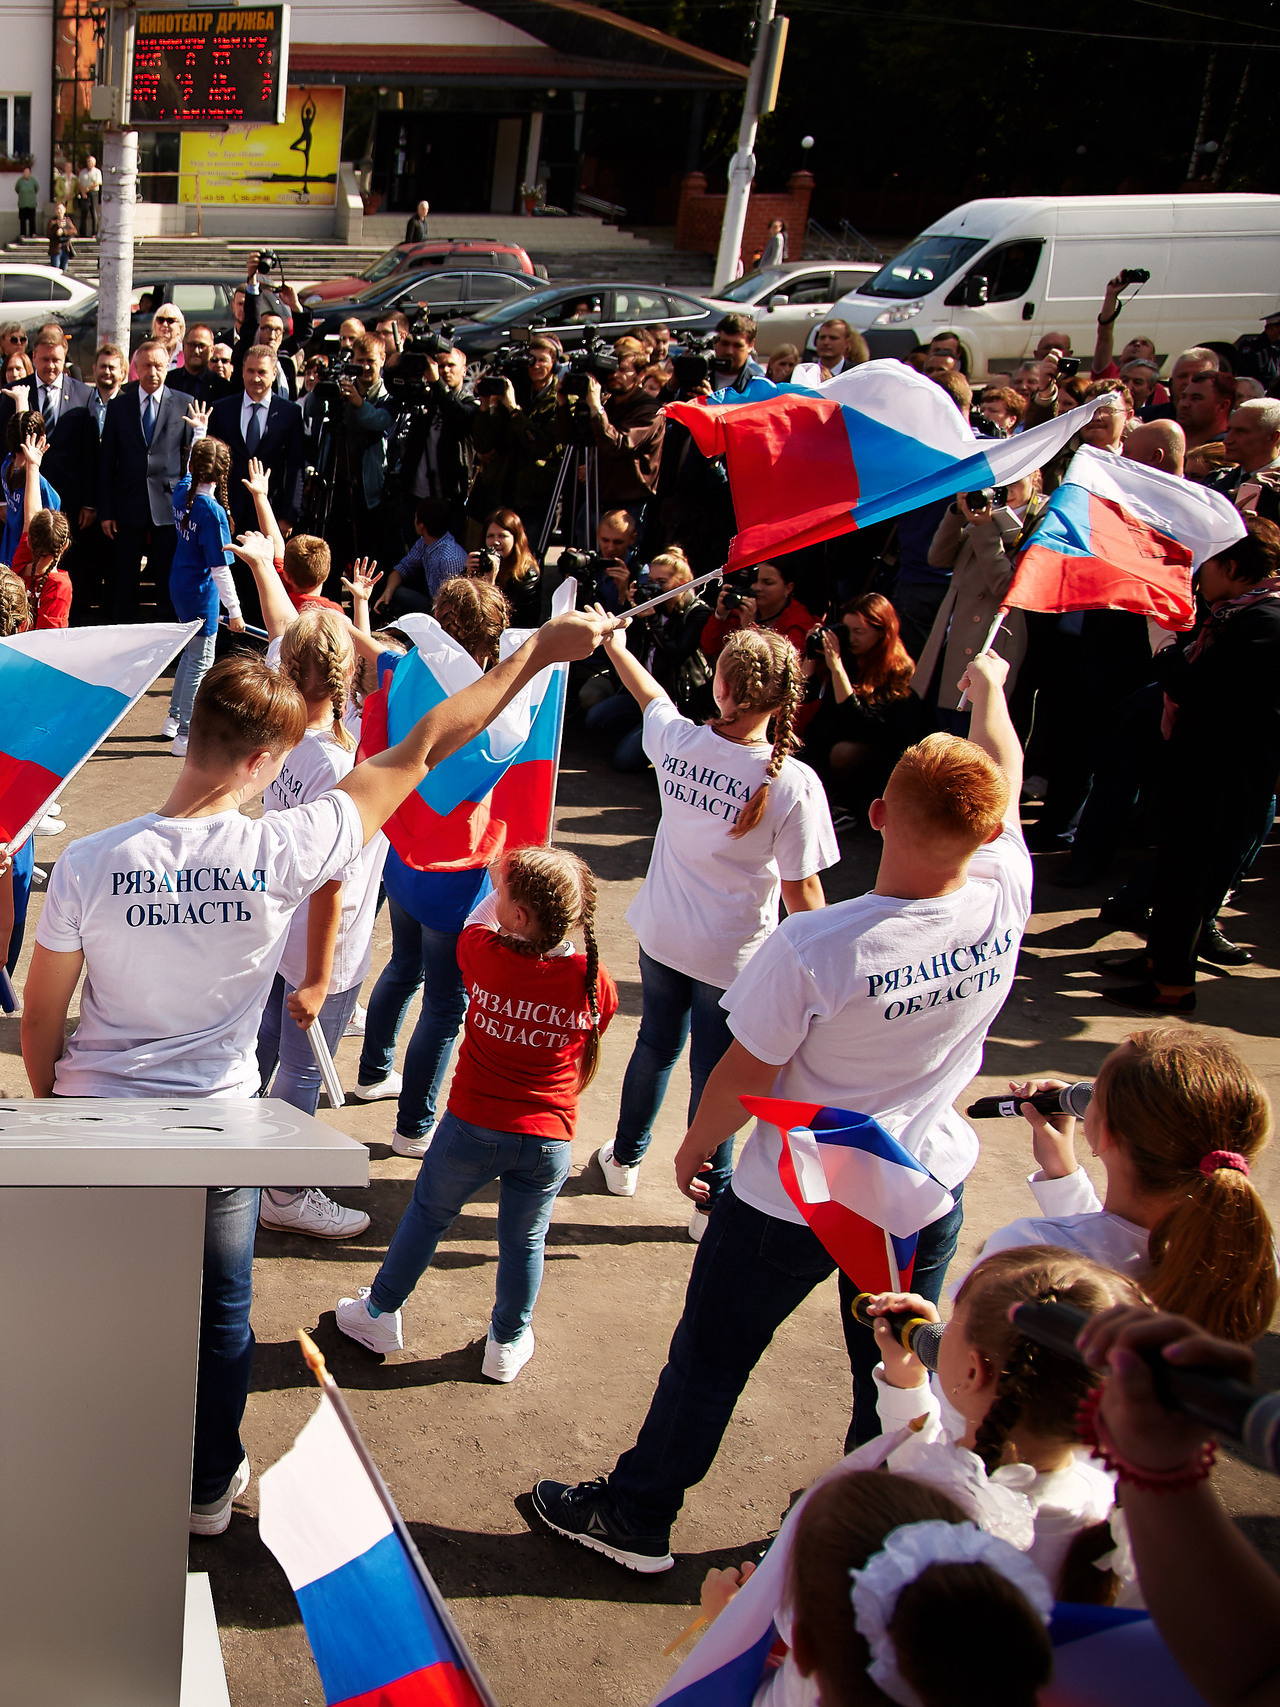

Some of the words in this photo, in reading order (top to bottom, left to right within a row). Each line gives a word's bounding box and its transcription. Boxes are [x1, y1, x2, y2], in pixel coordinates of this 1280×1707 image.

[139, 12, 213, 34] КИНОТЕАТР
[216, 11, 275, 34] ДРУЖБА
[661, 753, 751, 803] РЯЗАНСКА
[111, 867, 267, 896] РЯЗАНСКАЯ
[126, 901, 252, 927] ОБЛАСТЬ
[865, 928, 1014, 998] РЯЗАНСКАЯ
[471, 982, 591, 1031] РЯЗАНСКАЯ
[884, 966, 1001, 1021] ОБЛАСТЬ
[473, 1011, 570, 1048] ОБЛАСТЬ
